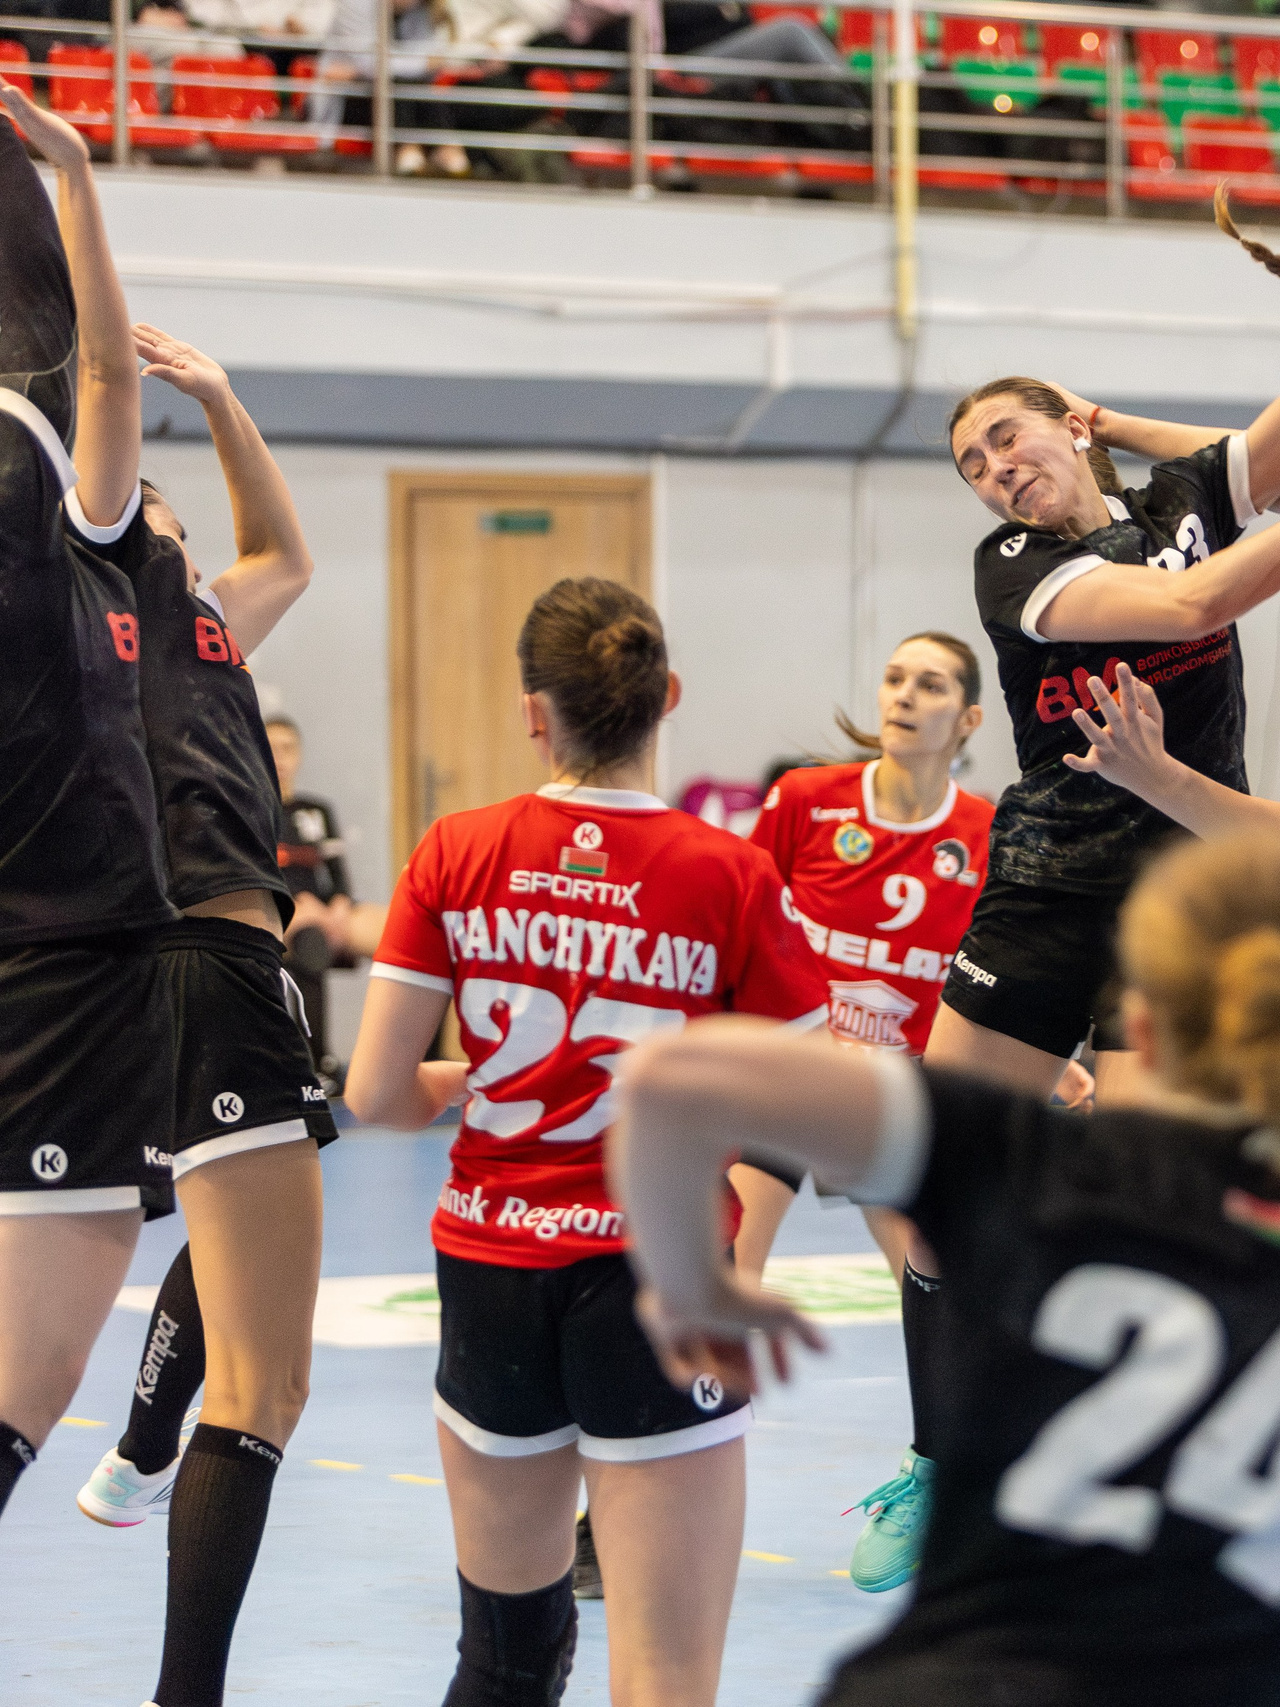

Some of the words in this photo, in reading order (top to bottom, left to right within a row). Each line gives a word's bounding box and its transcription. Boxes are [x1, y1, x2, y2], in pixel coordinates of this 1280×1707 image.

[508, 870, 643, 918] SPORTIX
[875, 873, 927, 932] 9
[954, 950, 998, 988] Kempa
[136, 1309, 180, 1406] Kempa
